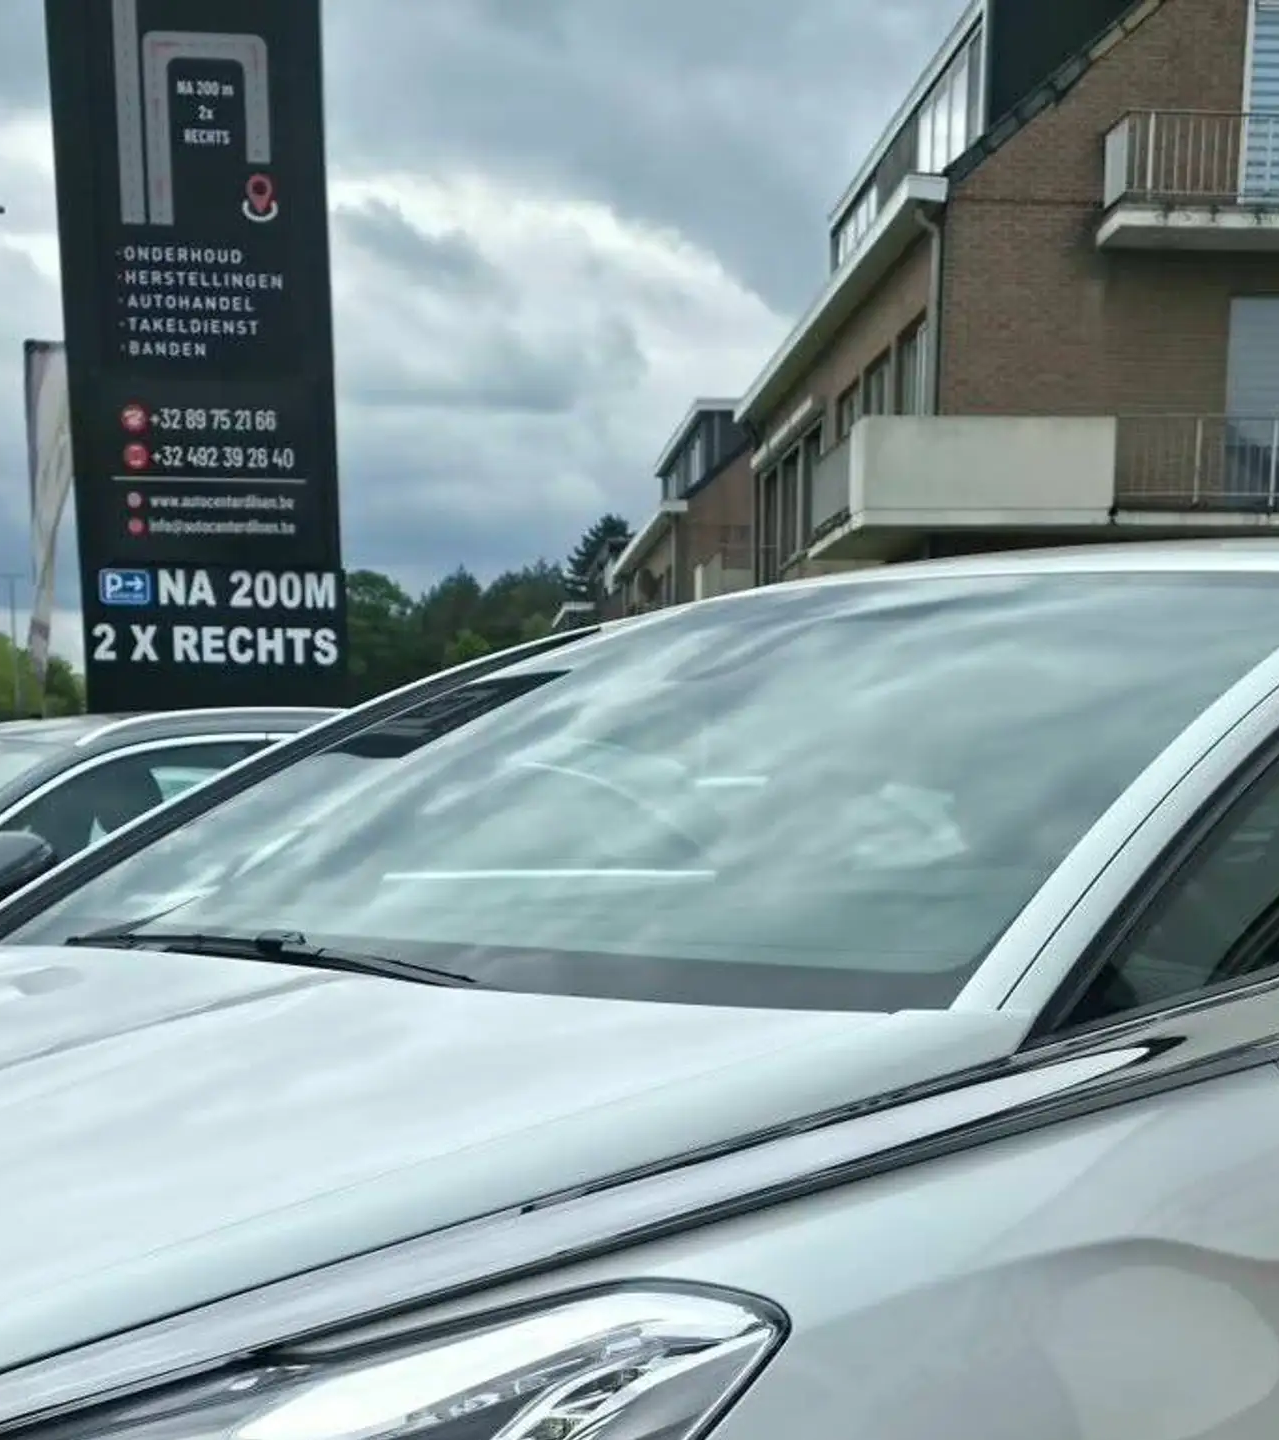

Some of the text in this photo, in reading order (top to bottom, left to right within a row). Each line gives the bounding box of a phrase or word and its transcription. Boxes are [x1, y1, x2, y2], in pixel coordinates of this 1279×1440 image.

[177, 80, 193, 95] NA
[197, 80, 220, 96] 200
[184, 128, 231, 145] RECHTS
[123, 246, 243, 265] ONDERHOUD
[124, 270, 284, 290] HERSTELLINGEN
[128, 293, 256, 312] AUTOHANDEL
[127, 316, 260, 336] TAKELDIENST
[128, 340, 207, 357] BANDEN
[149, 408, 182, 430] +32
[185, 408, 207, 430] 89
[209, 409, 231, 430] 75
[234, 409, 252, 431] 21
[151, 445, 183, 467] +32
[187, 446, 219, 468] 492
[223, 446, 244, 468] 39
[272, 447, 295, 469] 40
[157, 568, 217, 607] NA
[229, 569, 336, 609] 200M
[91, 623, 339, 665] 2 X RECHTS
